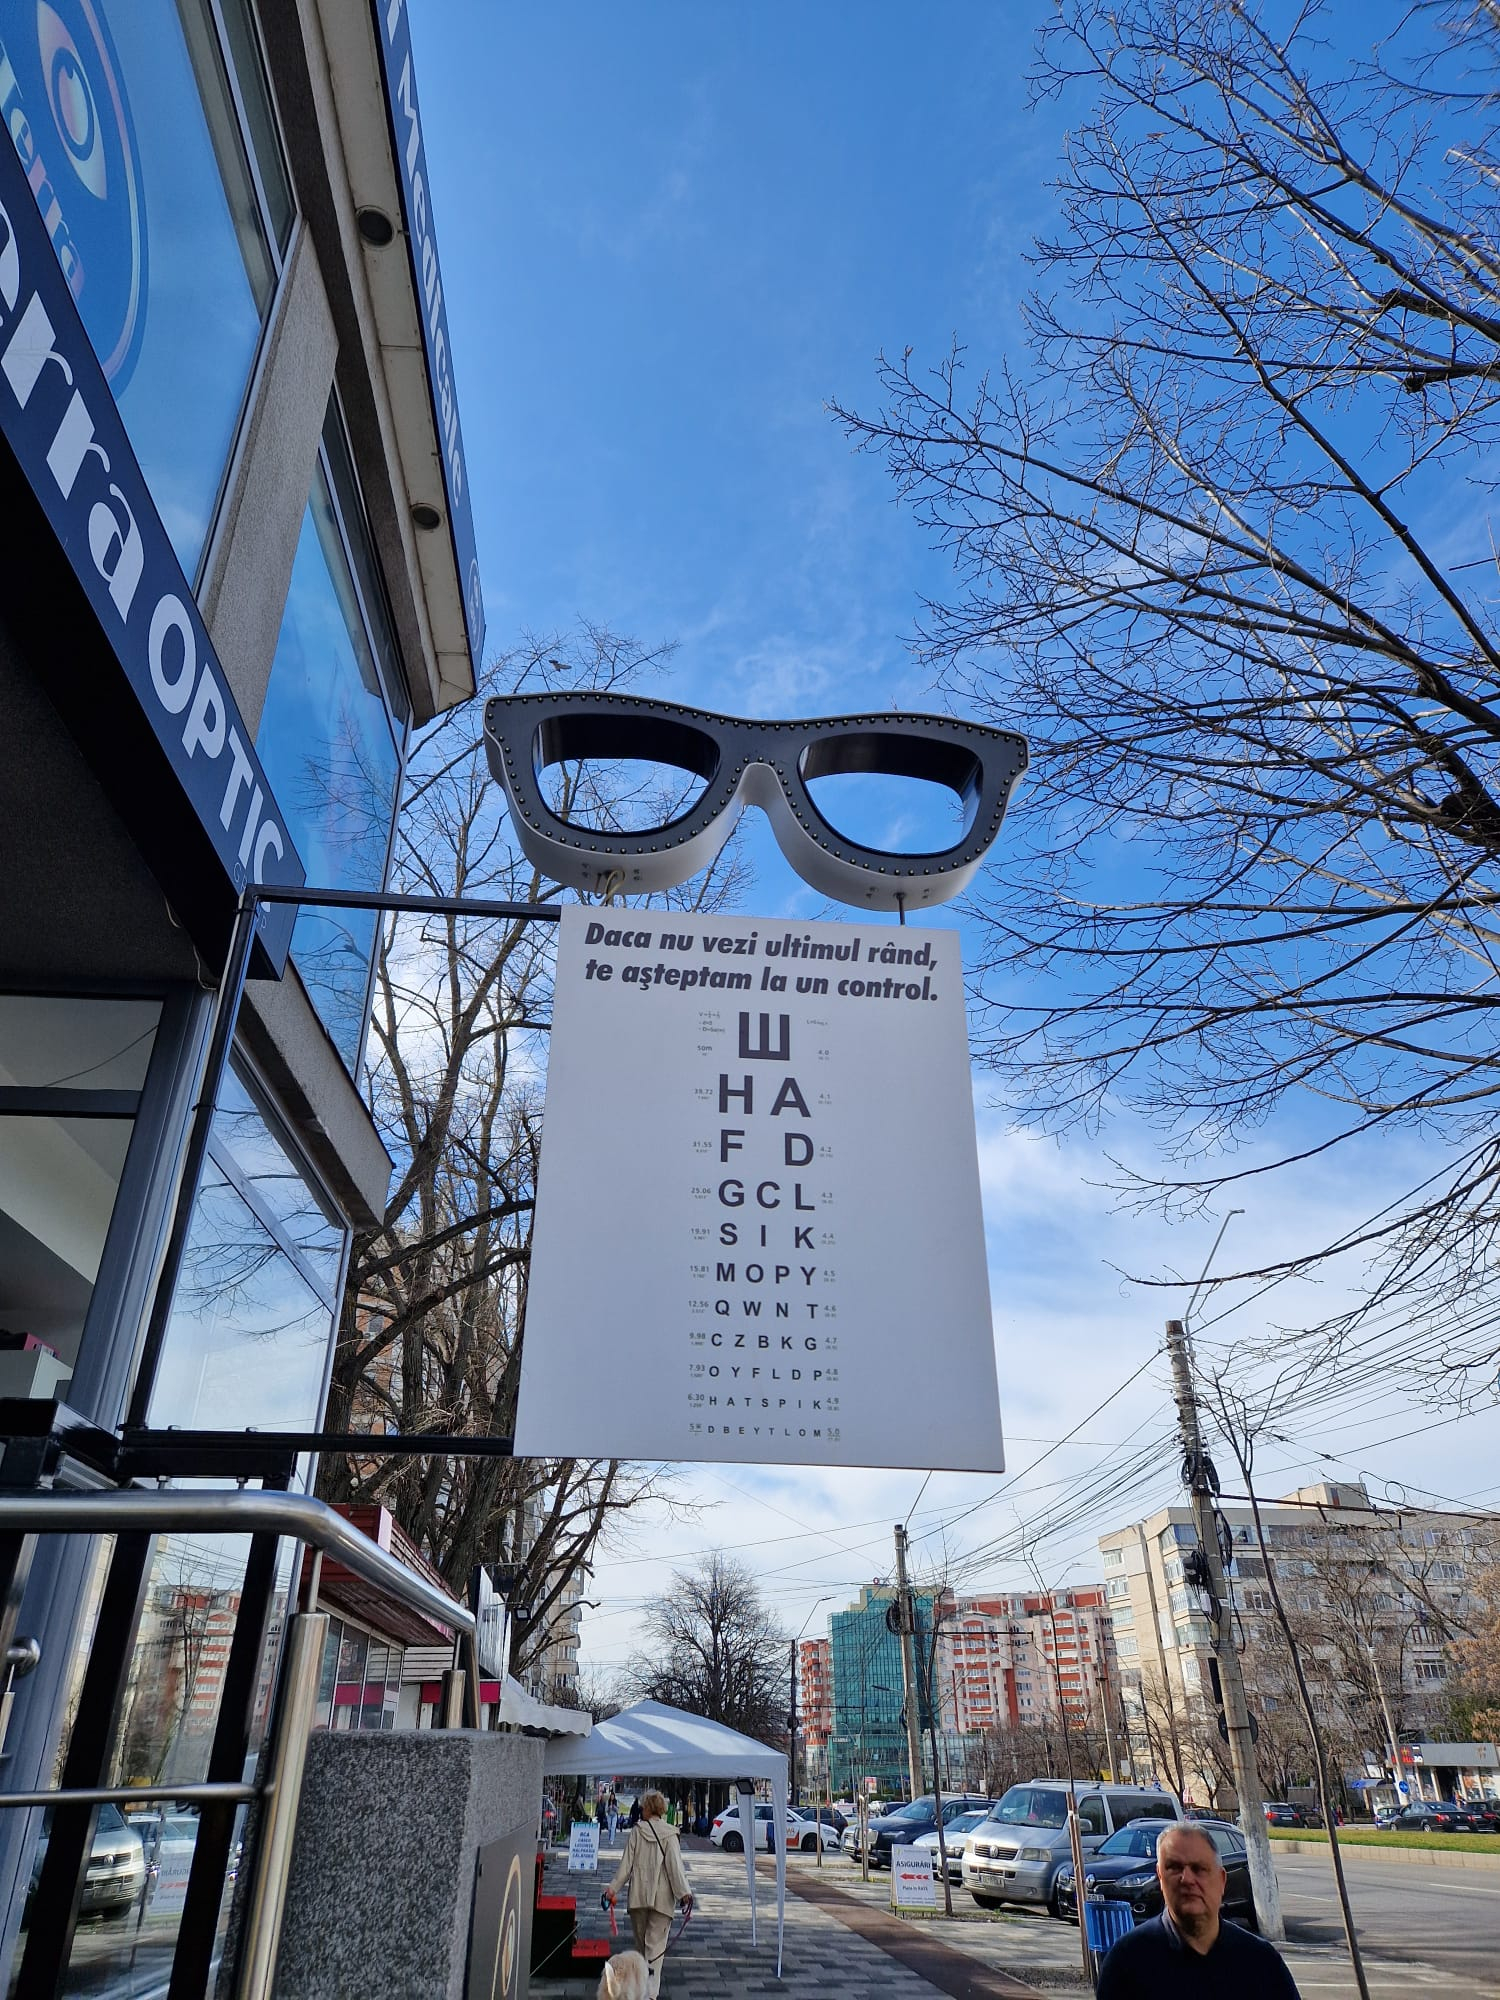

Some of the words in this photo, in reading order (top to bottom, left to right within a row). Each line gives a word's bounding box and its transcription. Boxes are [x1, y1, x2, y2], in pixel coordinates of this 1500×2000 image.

[397, 49, 463, 508] Medicale
[585, 922, 652, 949] Daca
[659, 934, 695, 953] nu
[702, 932, 759, 955] vezi
[765, 933, 861, 962] ultimul
[867, 942, 938, 972] rând,
[585, 958, 614, 983] te
[760, 967, 788, 992] la
[795, 976, 829, 995] un
[837, 975, 938, 1002] control.
